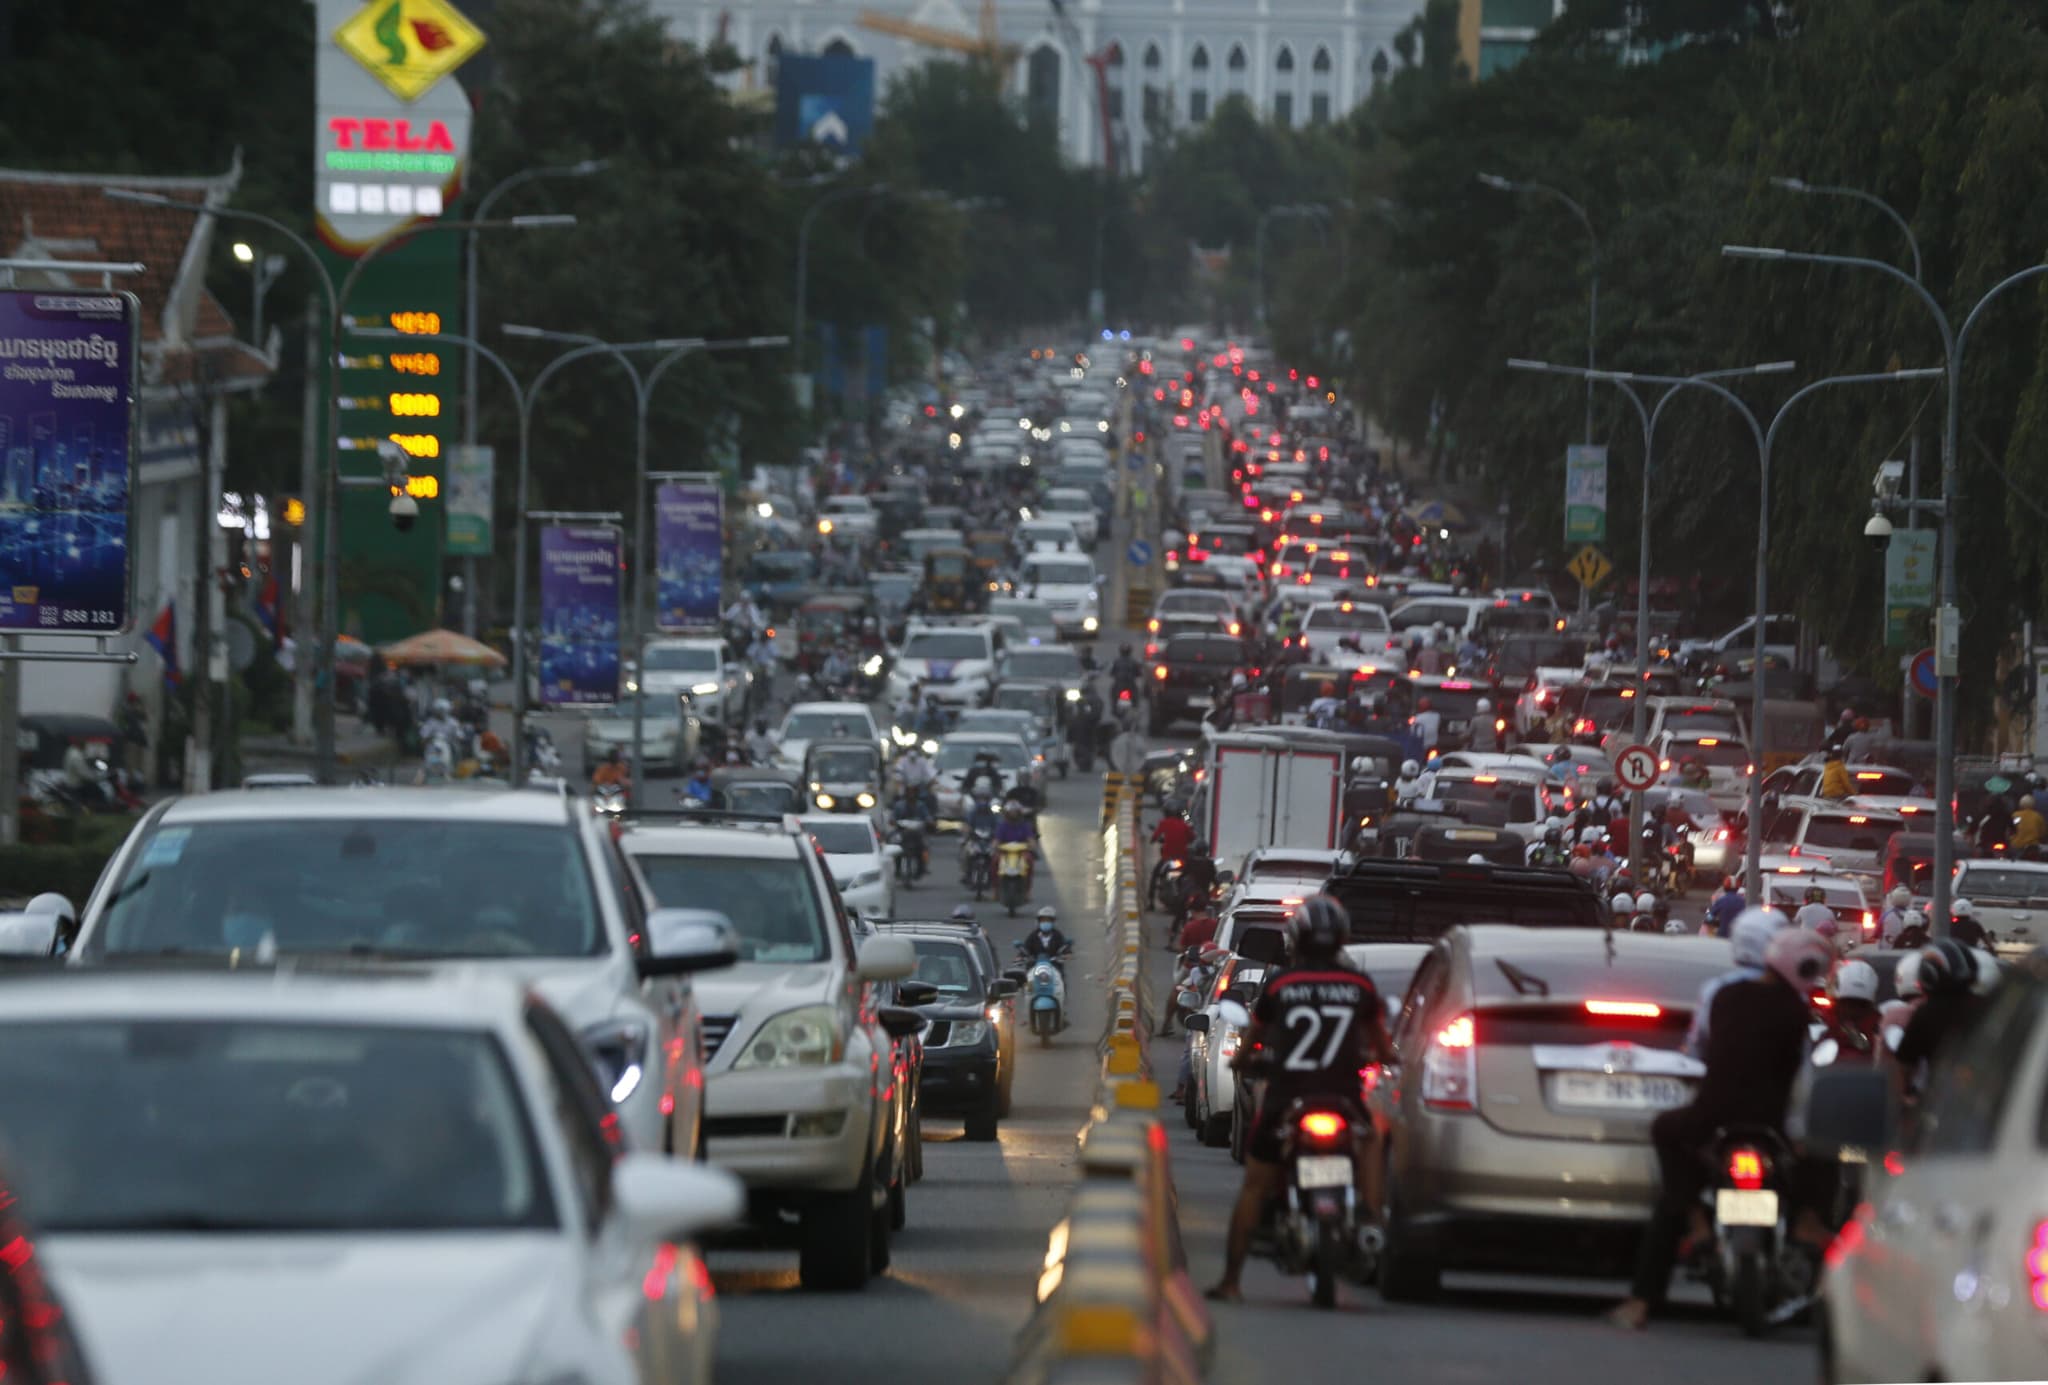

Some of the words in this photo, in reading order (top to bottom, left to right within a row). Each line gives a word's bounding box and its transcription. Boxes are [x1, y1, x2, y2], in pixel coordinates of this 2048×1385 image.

[329, 118, 455, 152] TELA
[390, 312, 441, 335] 4050
[390, 352, 440, 376] 4450
[389, 393, 440, 417] 5000
[62, 609, 89, 623] 888
[91, 610, 115, 624] 181
[1285, 1006, 1354, 1070] 27
